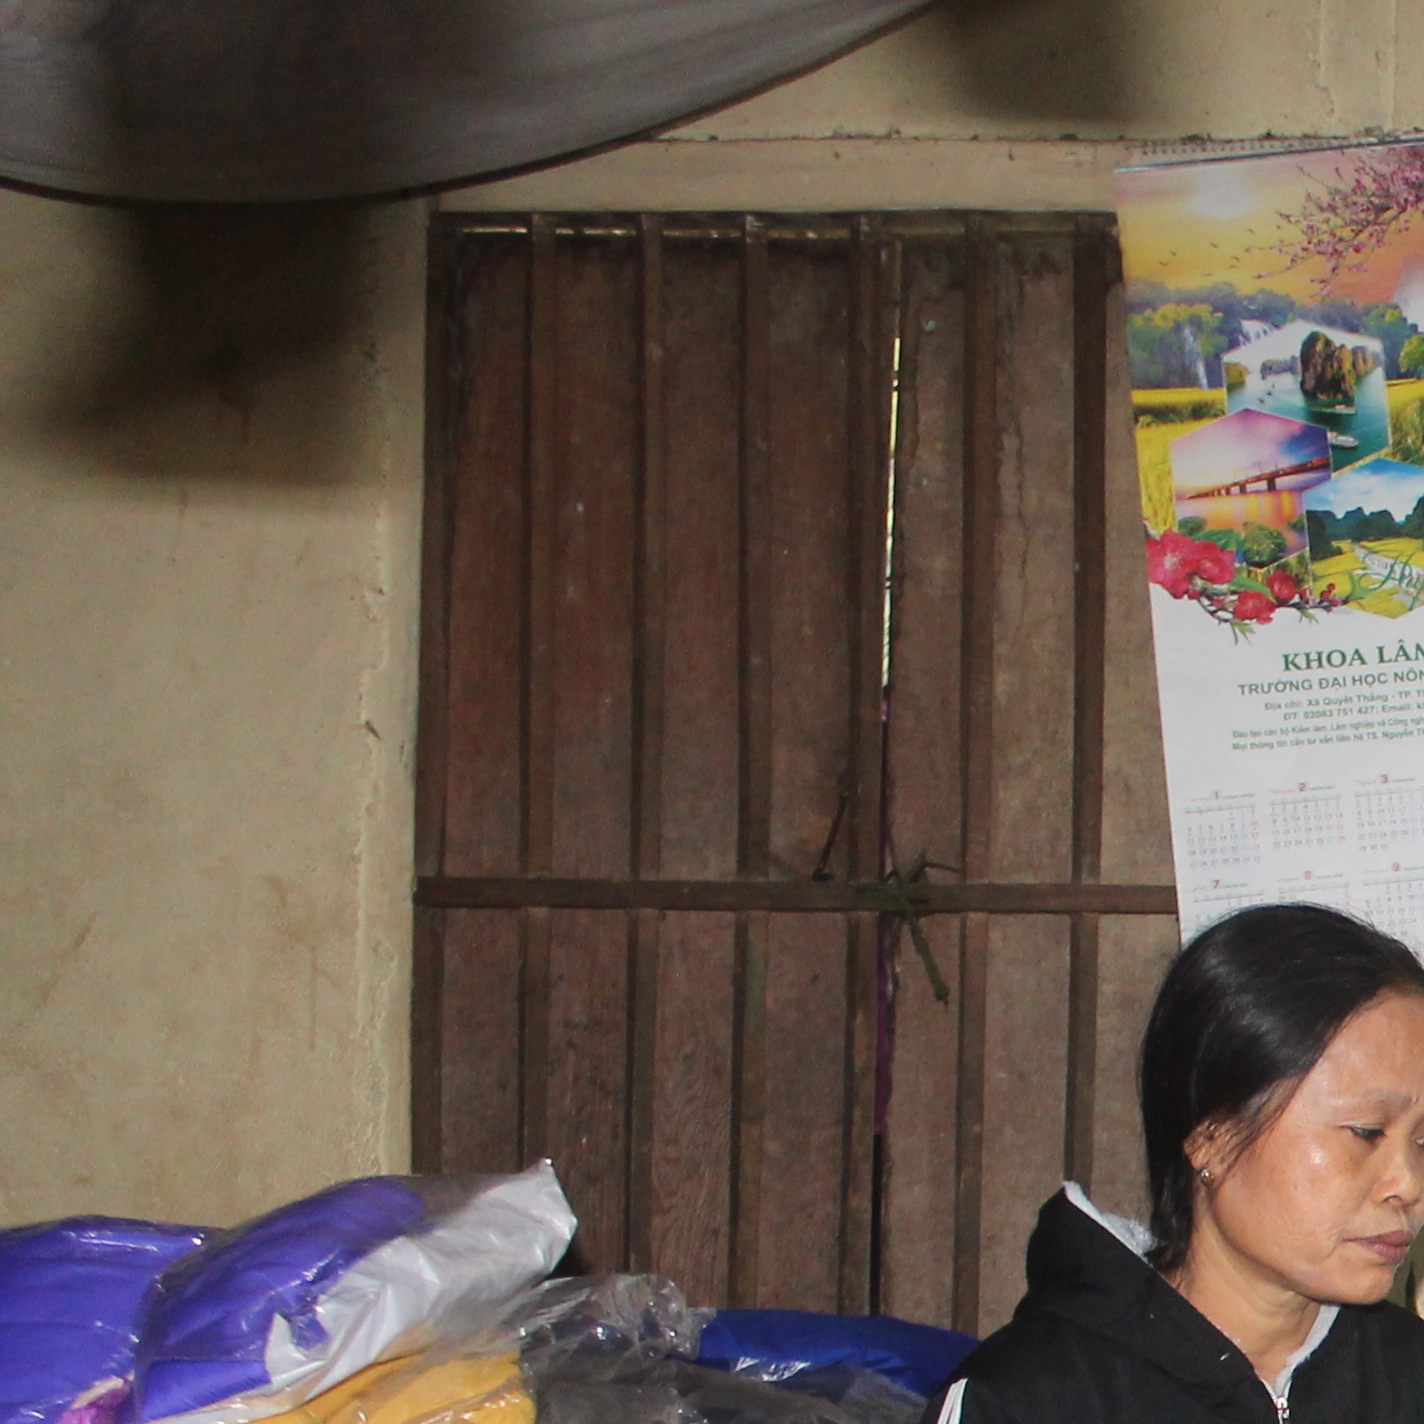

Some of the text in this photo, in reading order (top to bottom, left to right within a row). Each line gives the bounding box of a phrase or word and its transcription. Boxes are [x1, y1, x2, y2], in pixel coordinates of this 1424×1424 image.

[1282, 648, 1367, 673] KHOA
[1238, 679, 1312, 697] TRƯỜNG
[1318, 676, 1347, 692] ĐẠI
[1352, 672, 1388, 689] HỌC
